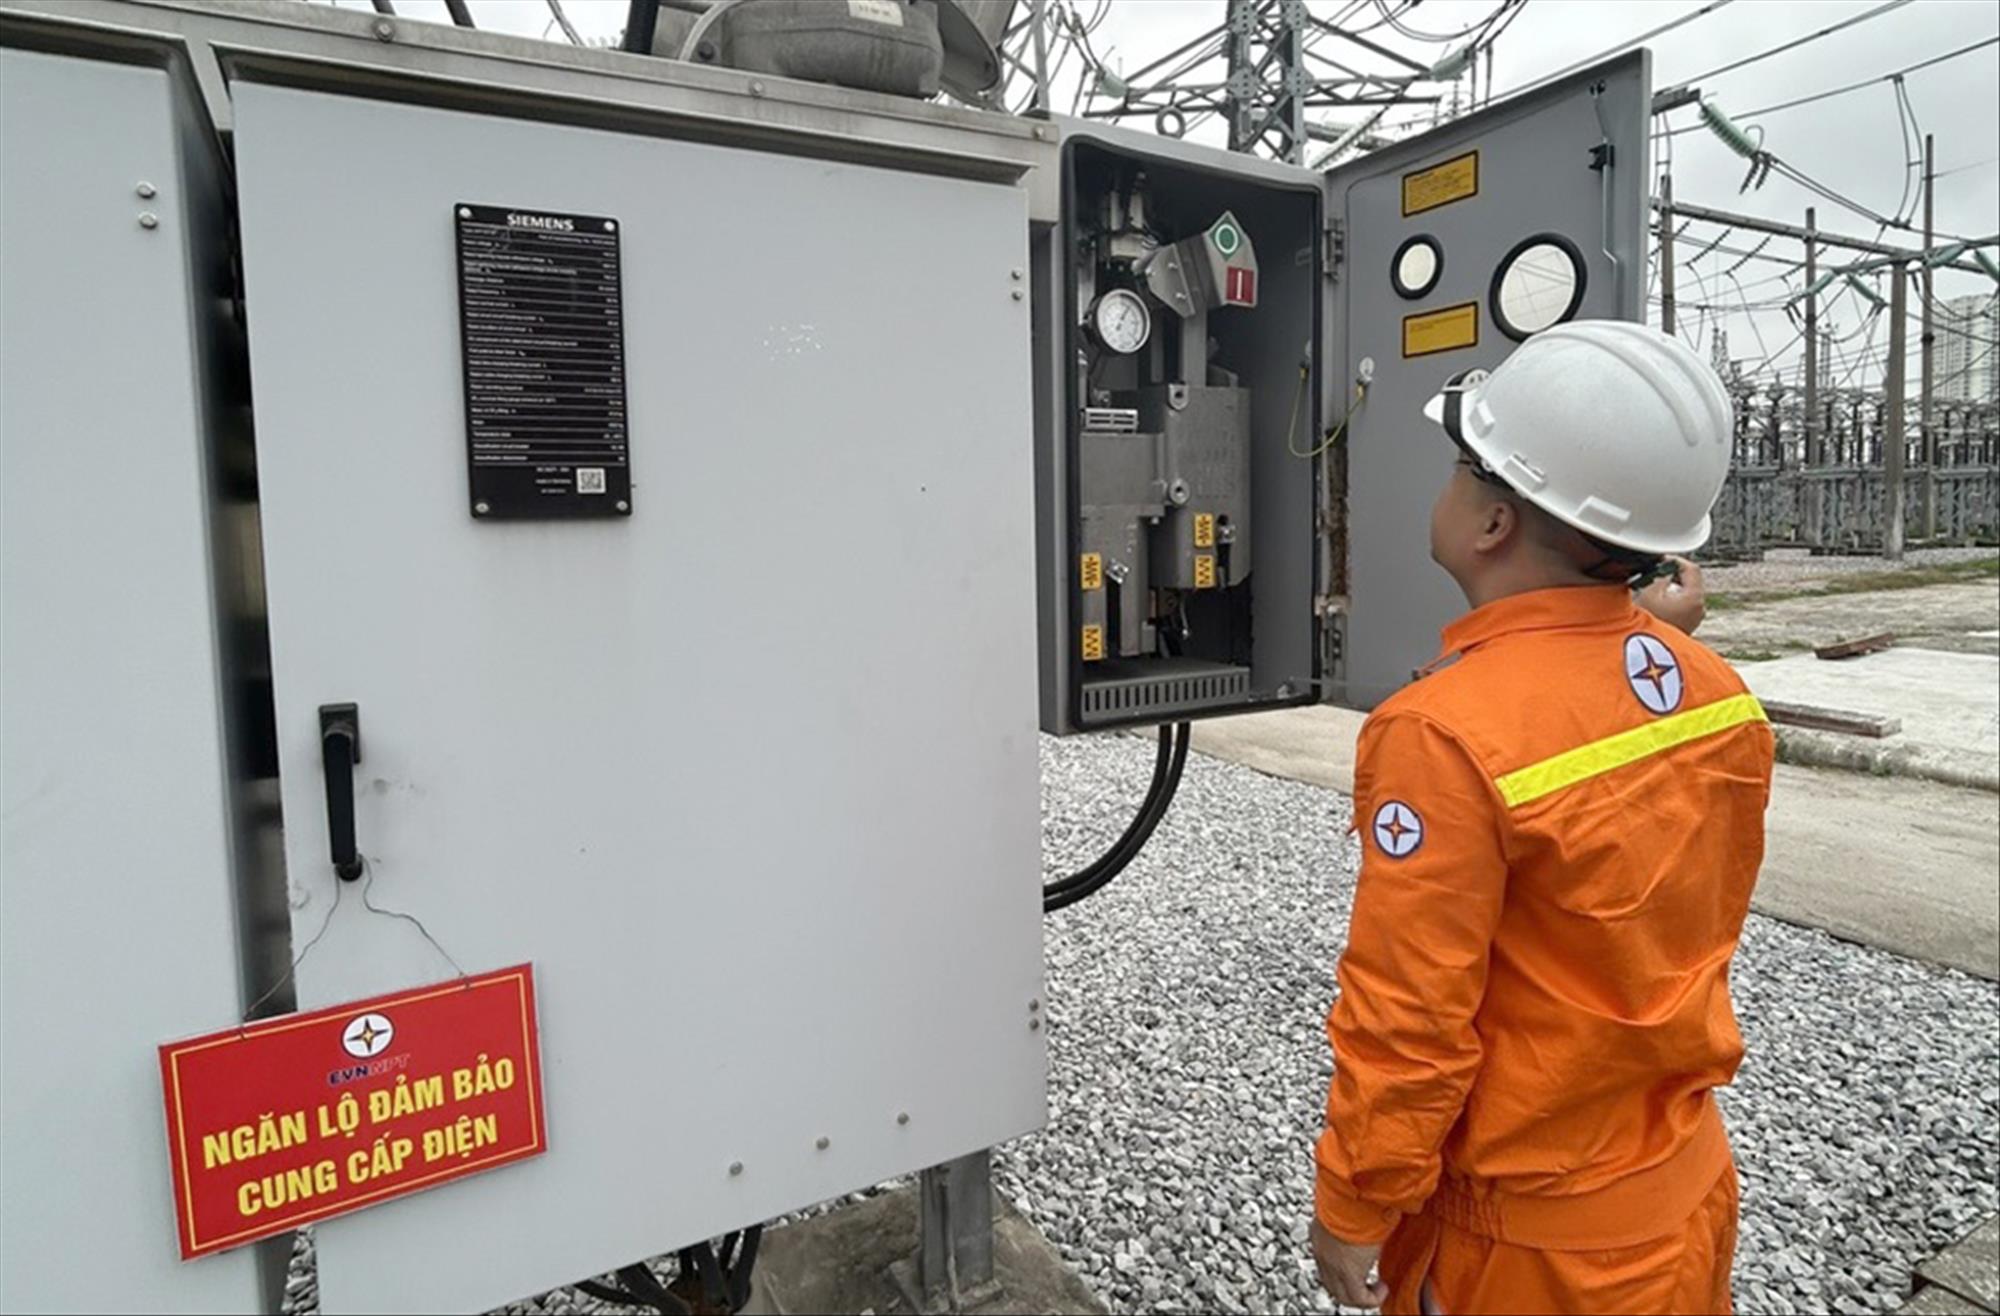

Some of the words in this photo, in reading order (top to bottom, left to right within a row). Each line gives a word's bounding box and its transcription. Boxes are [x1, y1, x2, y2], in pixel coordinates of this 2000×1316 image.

[507, 213, 574, 232] SIEMENS
[203, 1111, 307, 1169] NGĂN
[318, 1092, 360, 1139] LỘ
[368, 1074, 445, 1124] ĐẢM
[452, 1054, 514, 1101] BẢO
[238, 1160, 338, 1216] CUNG
[347, 1131, 413, 1183] CẤP
[422, 1114, 497, 1162] ĐIỆN
